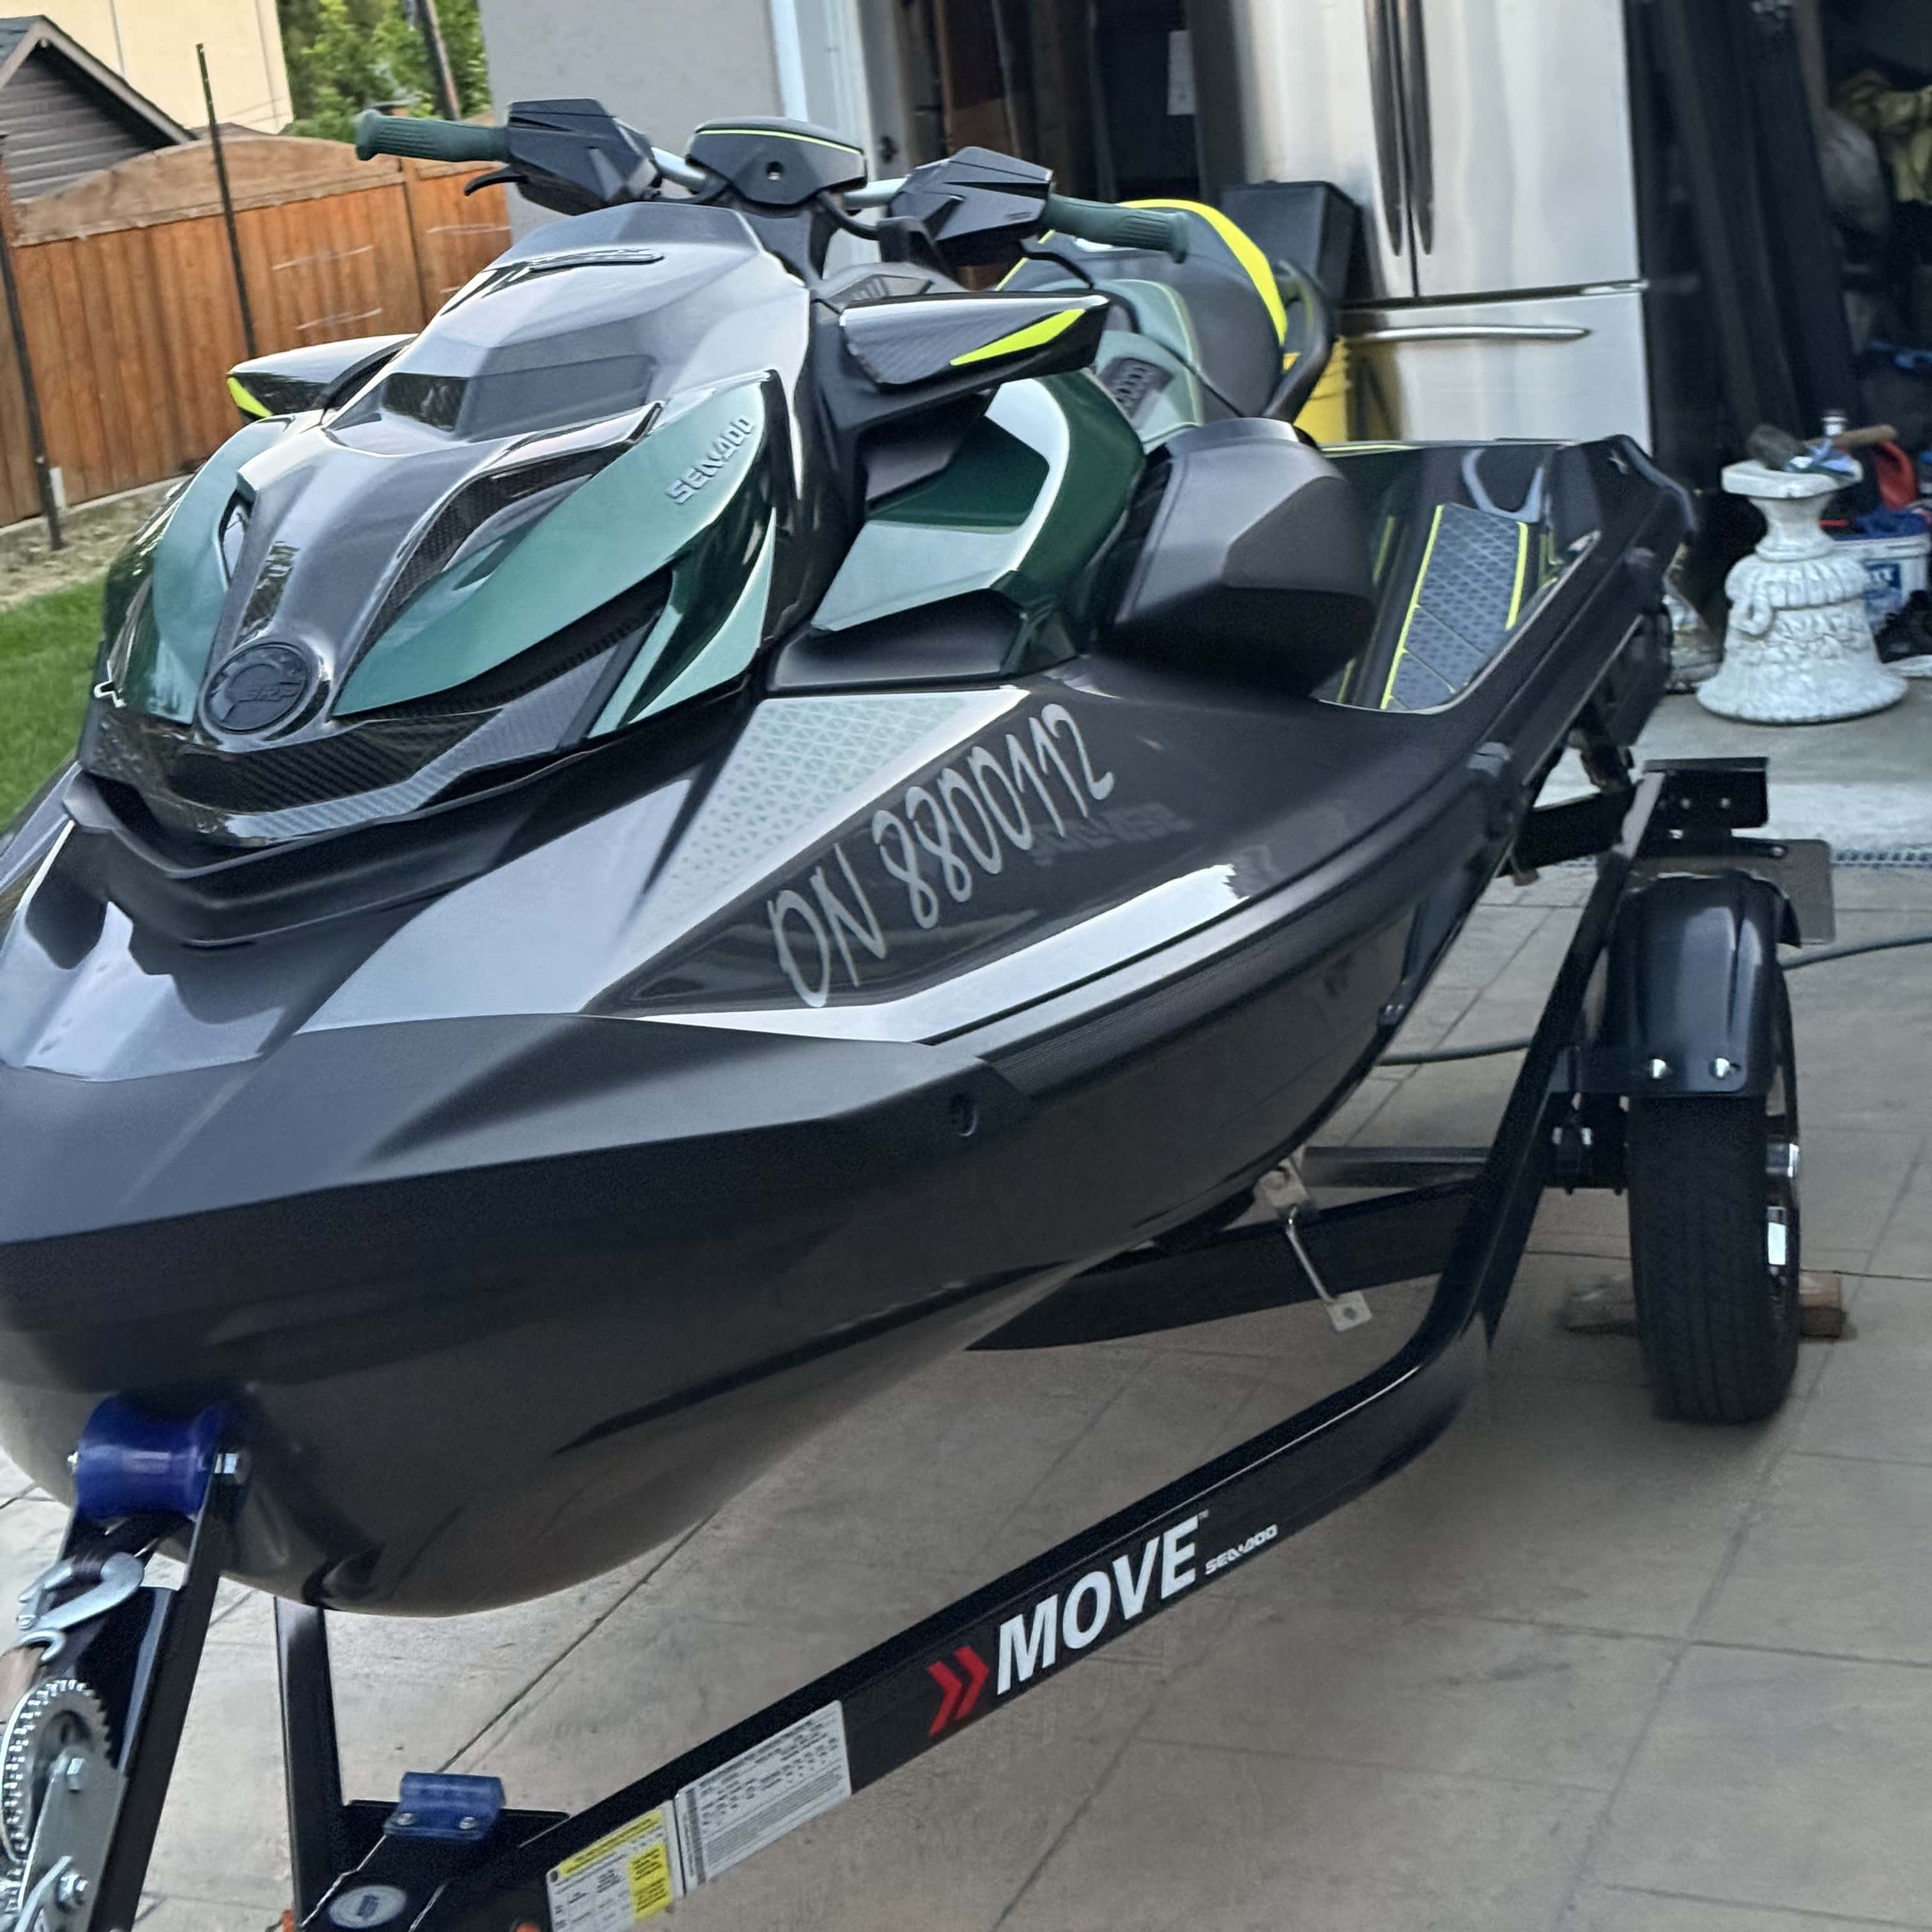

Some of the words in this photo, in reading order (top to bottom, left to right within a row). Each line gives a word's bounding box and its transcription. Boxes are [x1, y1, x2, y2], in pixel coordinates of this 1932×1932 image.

[767, 843, 886, 1008] ON
[872, 703, 1114, 929] 8800112
[997, 1515, 1198, 1695] MOVE
